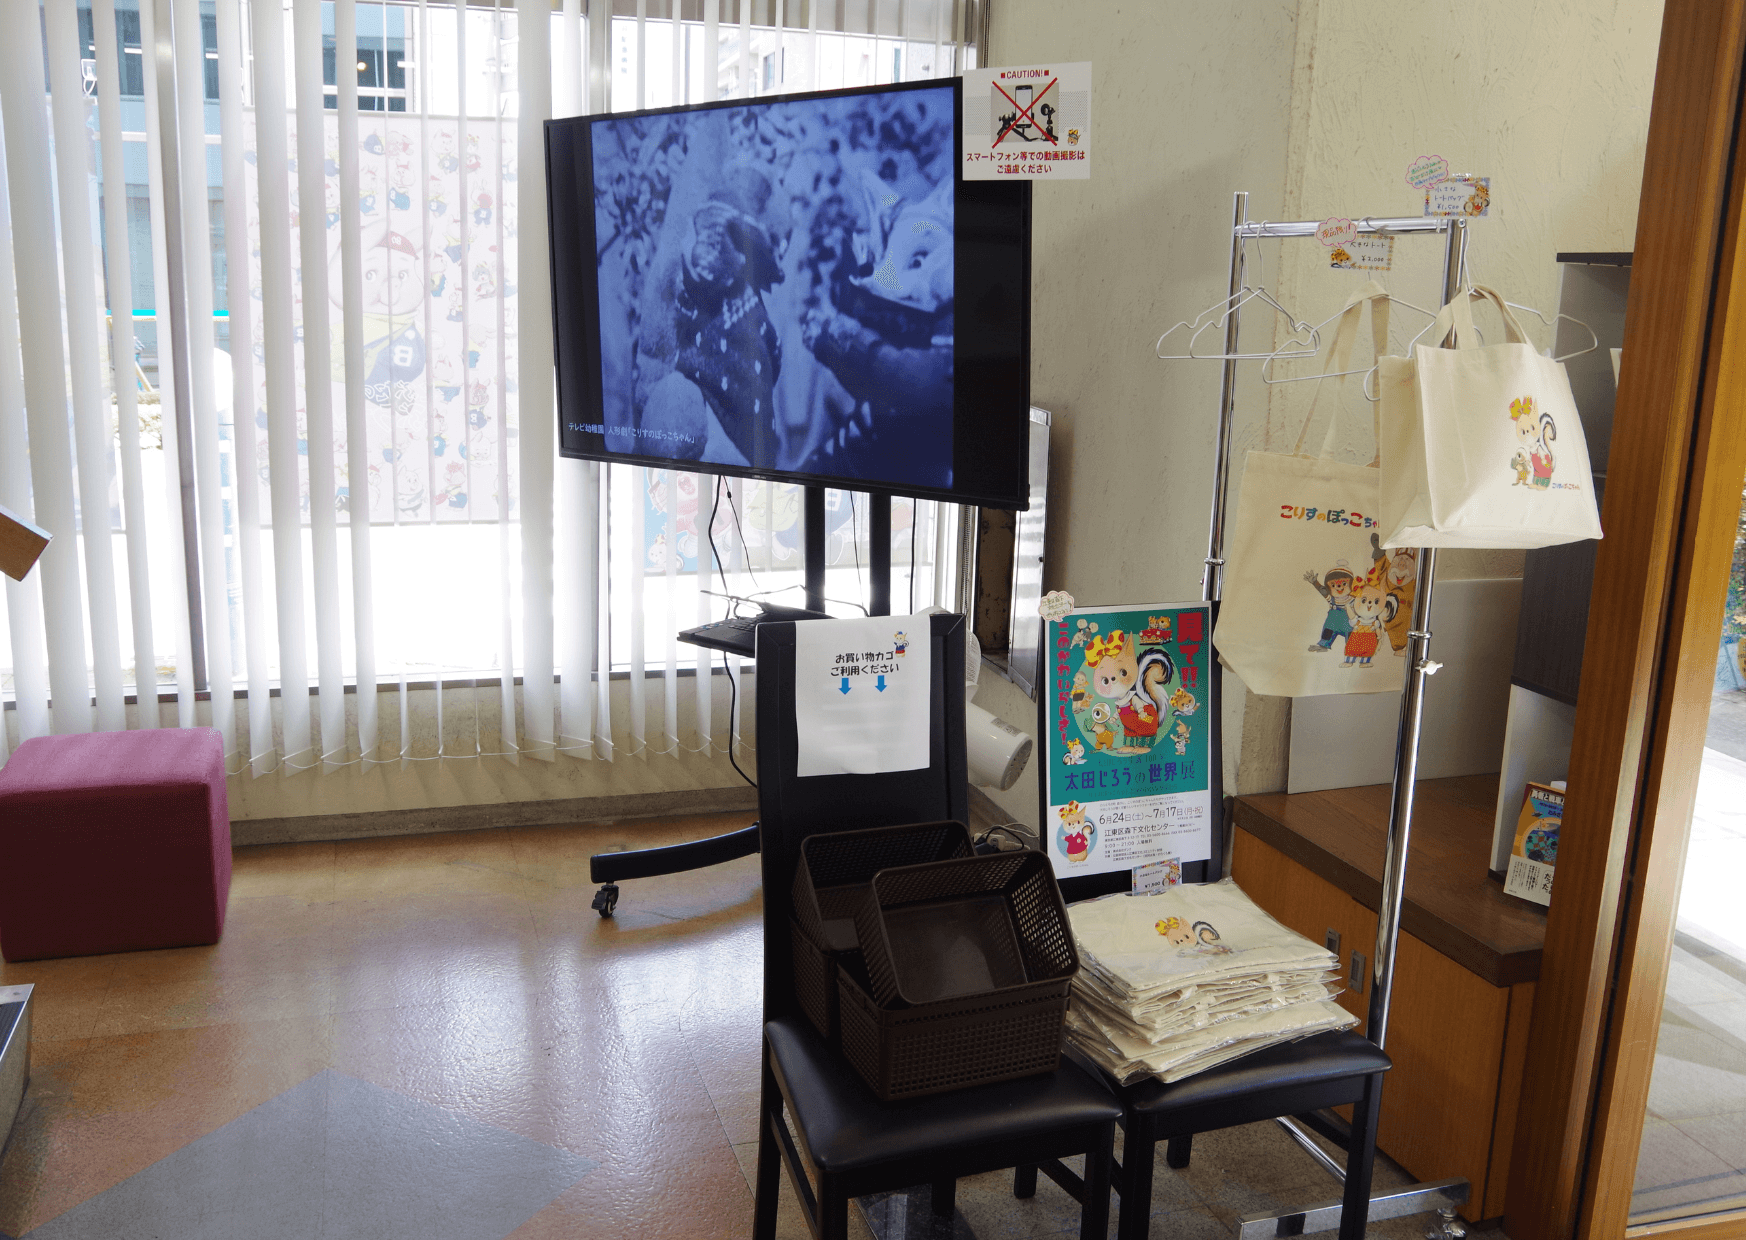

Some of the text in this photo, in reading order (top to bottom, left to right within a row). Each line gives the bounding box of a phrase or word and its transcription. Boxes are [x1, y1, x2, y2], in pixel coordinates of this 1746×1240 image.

[1007, 69, 1043, 79] CAUTION!
[966, 150, 1085, 161] スマートフォン等での動画撮影は
[997, 164, 1052, 174] ご遠慮ください
[568, 422, 605, 434] テレビ幼稚園
[835, 650, 894, 664] お買い物カゴ
[830, 663, 900, 676] ご利用ください
[1064, 760, 1195, 791] 太田じろうの世界展
[1104, 823, 1175, 837] 江東区森下文化センター
